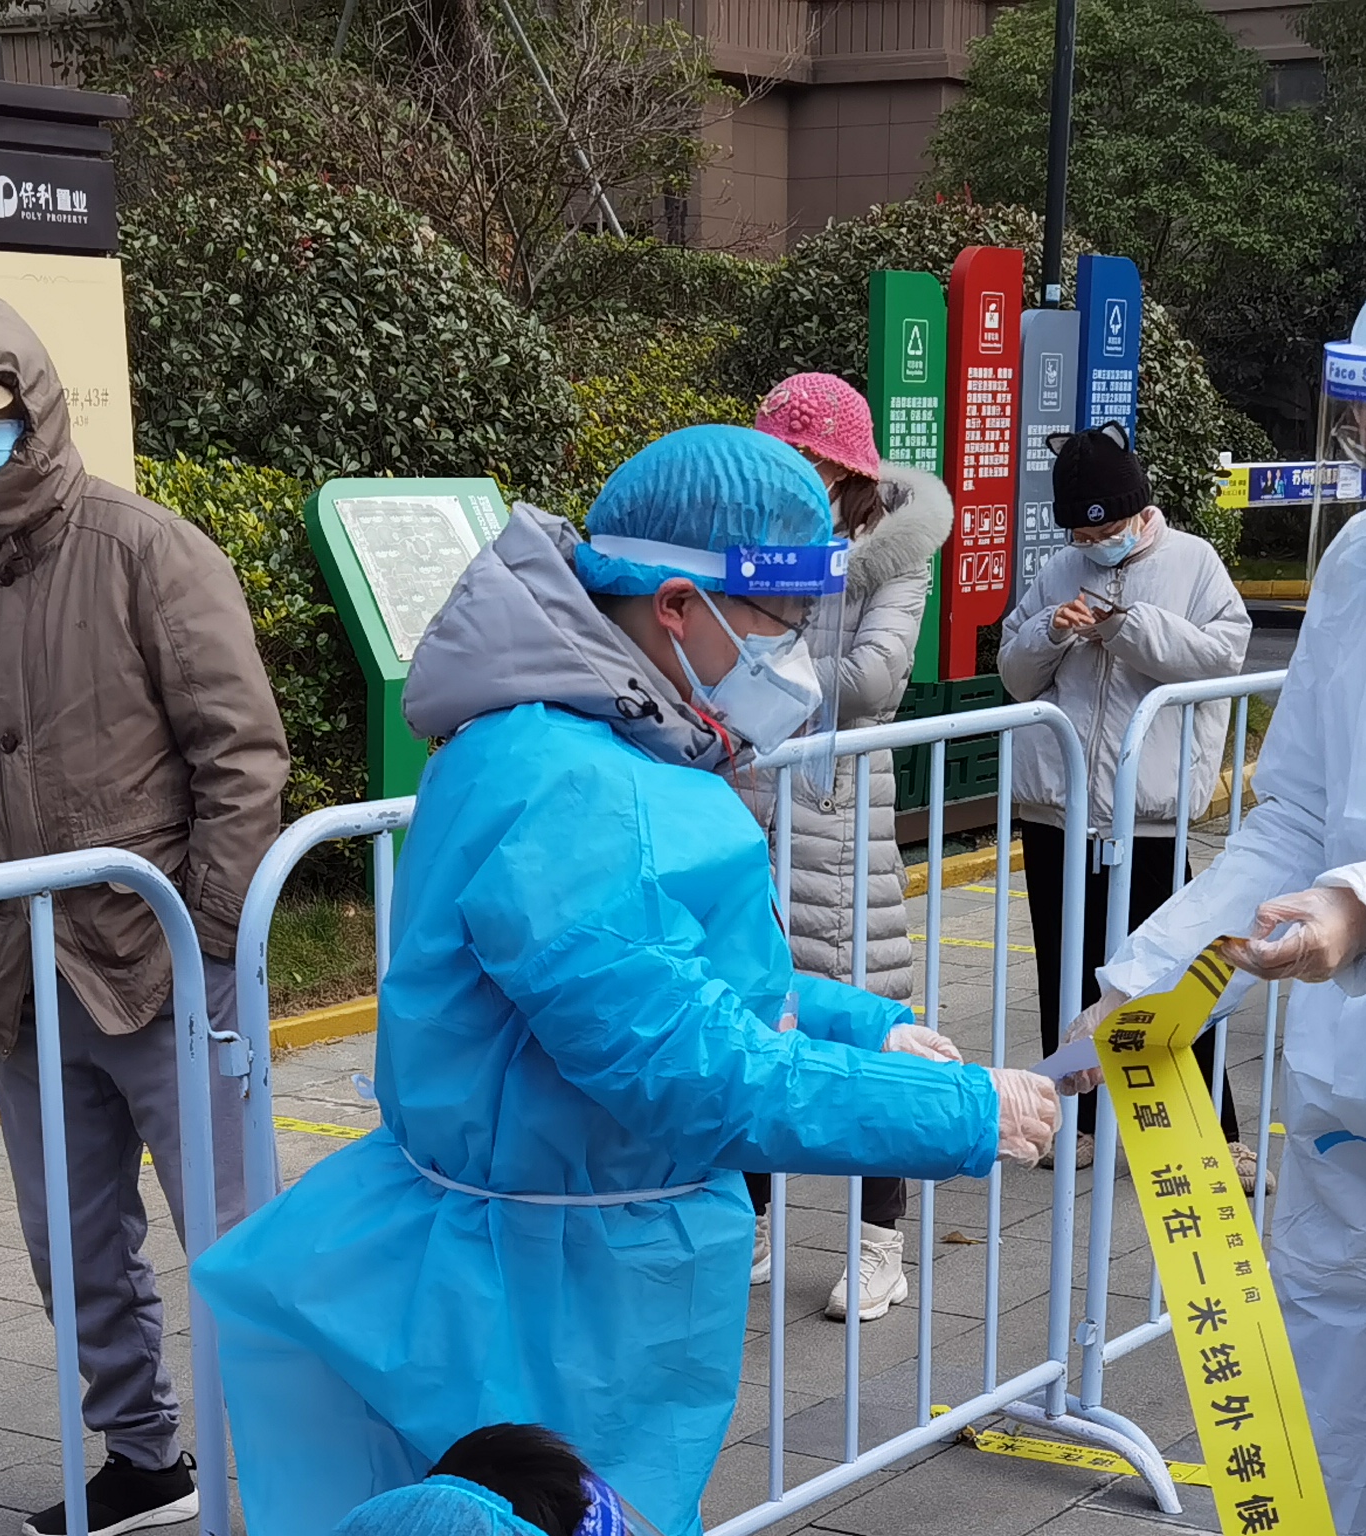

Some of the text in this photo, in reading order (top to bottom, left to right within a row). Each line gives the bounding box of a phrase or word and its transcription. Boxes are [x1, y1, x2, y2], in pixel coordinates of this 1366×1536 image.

[21, 210, 88, 224] POLY PROPERTY
[1328, 360, 1356, 381] Face
[1200, 1155, 1262, 1305] 疫情防控期间
[1107, 1010, 1280, 1536] 佩戴口罩 请在一米线外等候
